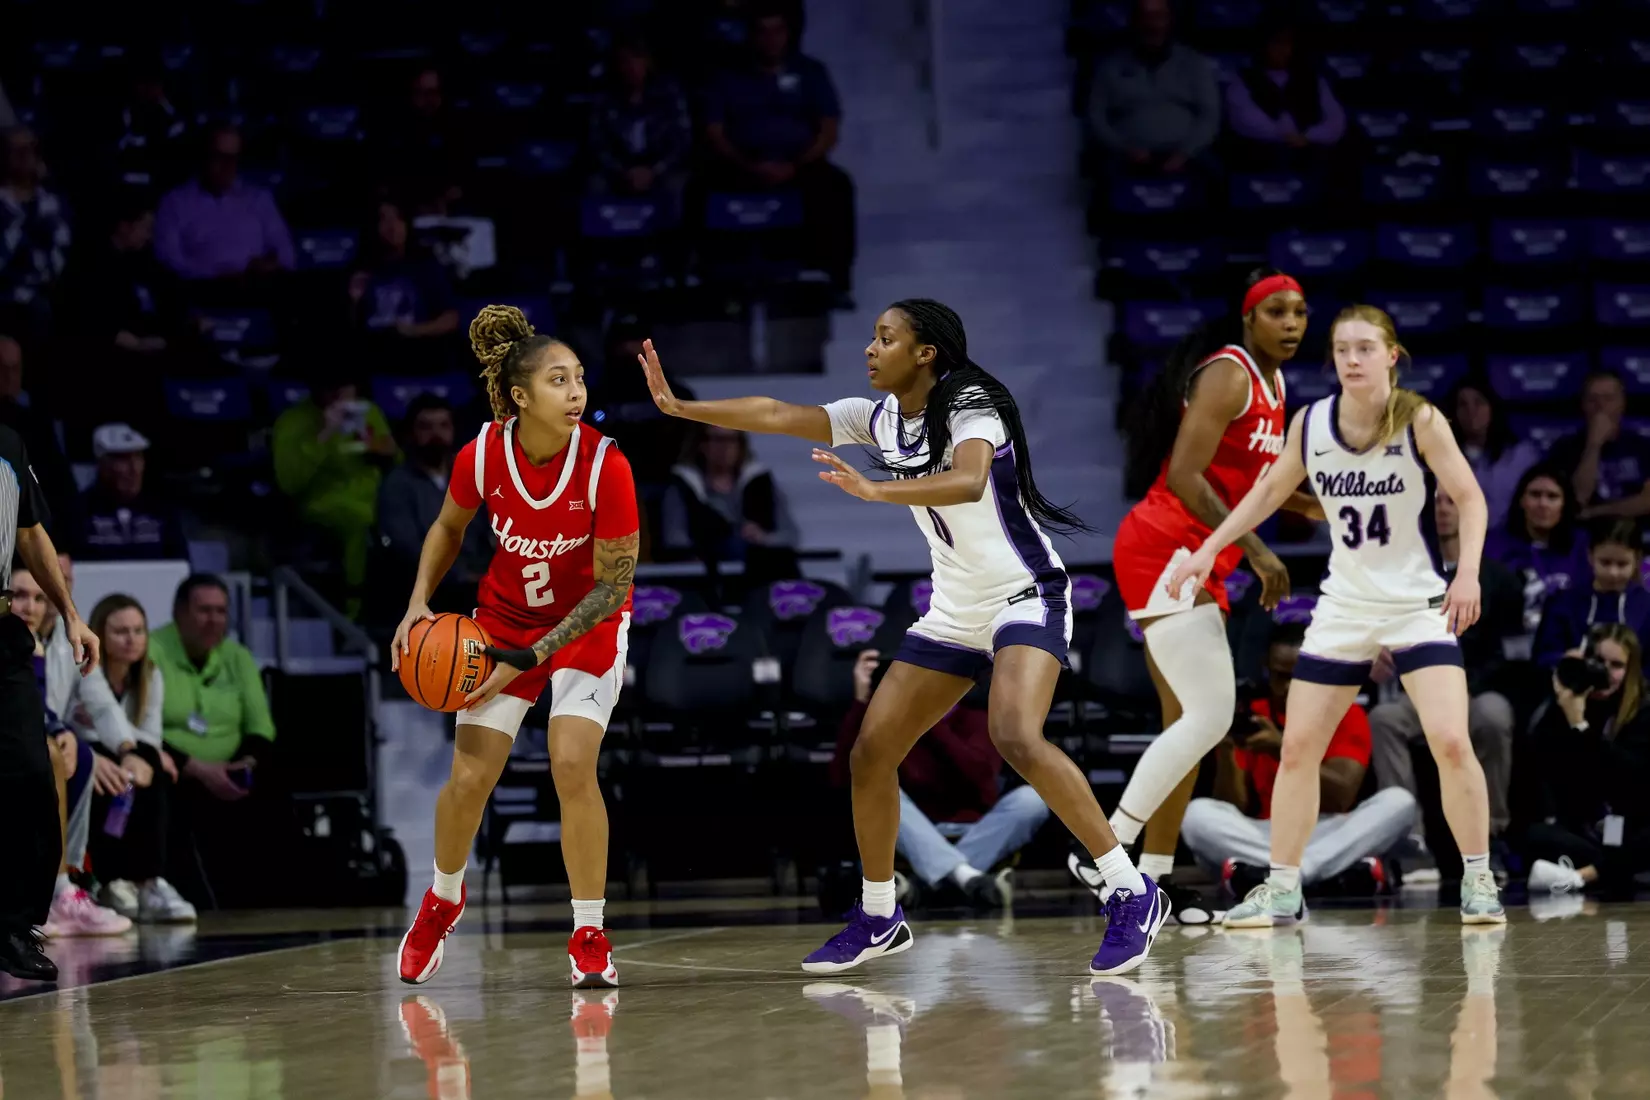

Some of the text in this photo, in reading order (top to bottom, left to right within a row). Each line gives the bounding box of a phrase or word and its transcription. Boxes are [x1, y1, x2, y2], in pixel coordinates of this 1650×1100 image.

[1315, 470, 1406, 497] Wildcats
[491, 512, 590, 560] Houston
[1338, 503, 1391, 550] 34
[521, 561, 555, 608] 2
[614, 555, 635, 586] 2
[455, 638, 468, 692] CHAIONSHIP
[459, 639, 481, 693] ELITE
